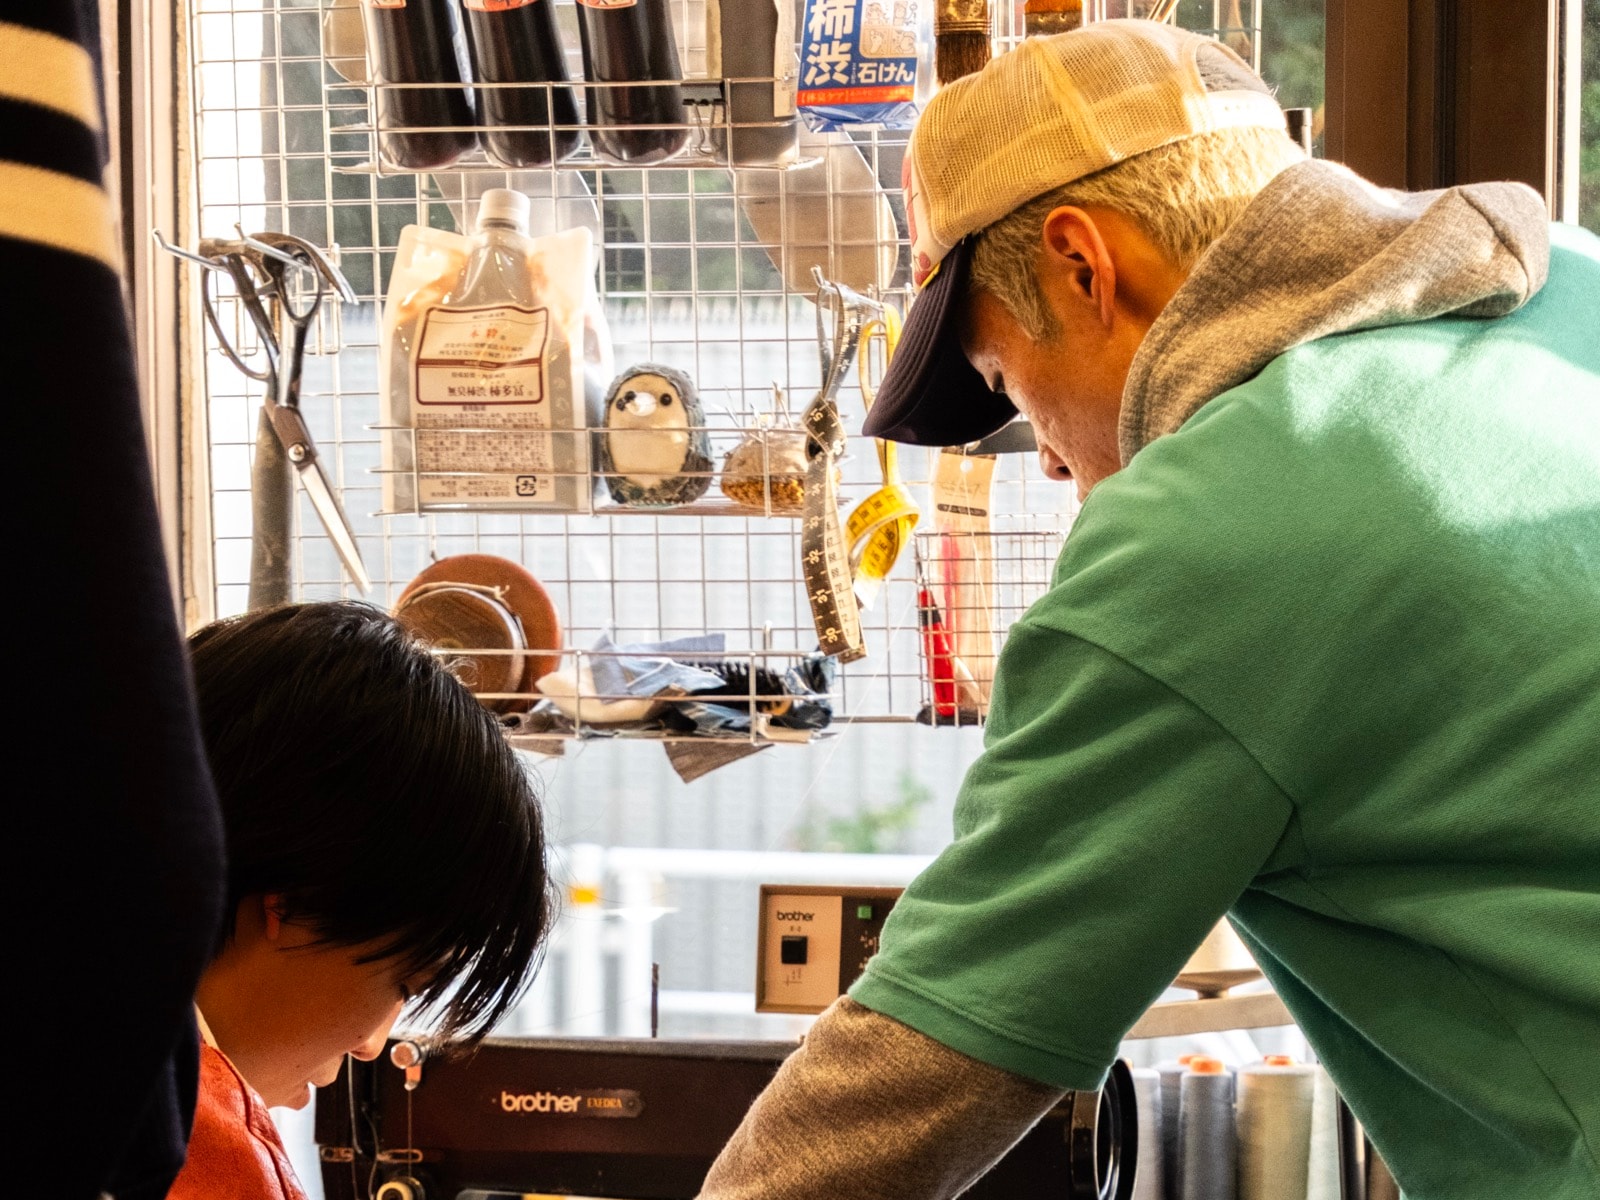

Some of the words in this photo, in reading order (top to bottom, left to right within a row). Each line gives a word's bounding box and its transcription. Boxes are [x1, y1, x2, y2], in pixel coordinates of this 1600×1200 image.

[804, 0, 856, 86] 柿渋
[857, 62, 914, 83] 石けん
[825, 627, 838, 644] 30
[777, 911, 815, 921] brother
[501, 1091, 582, 1112] brother
